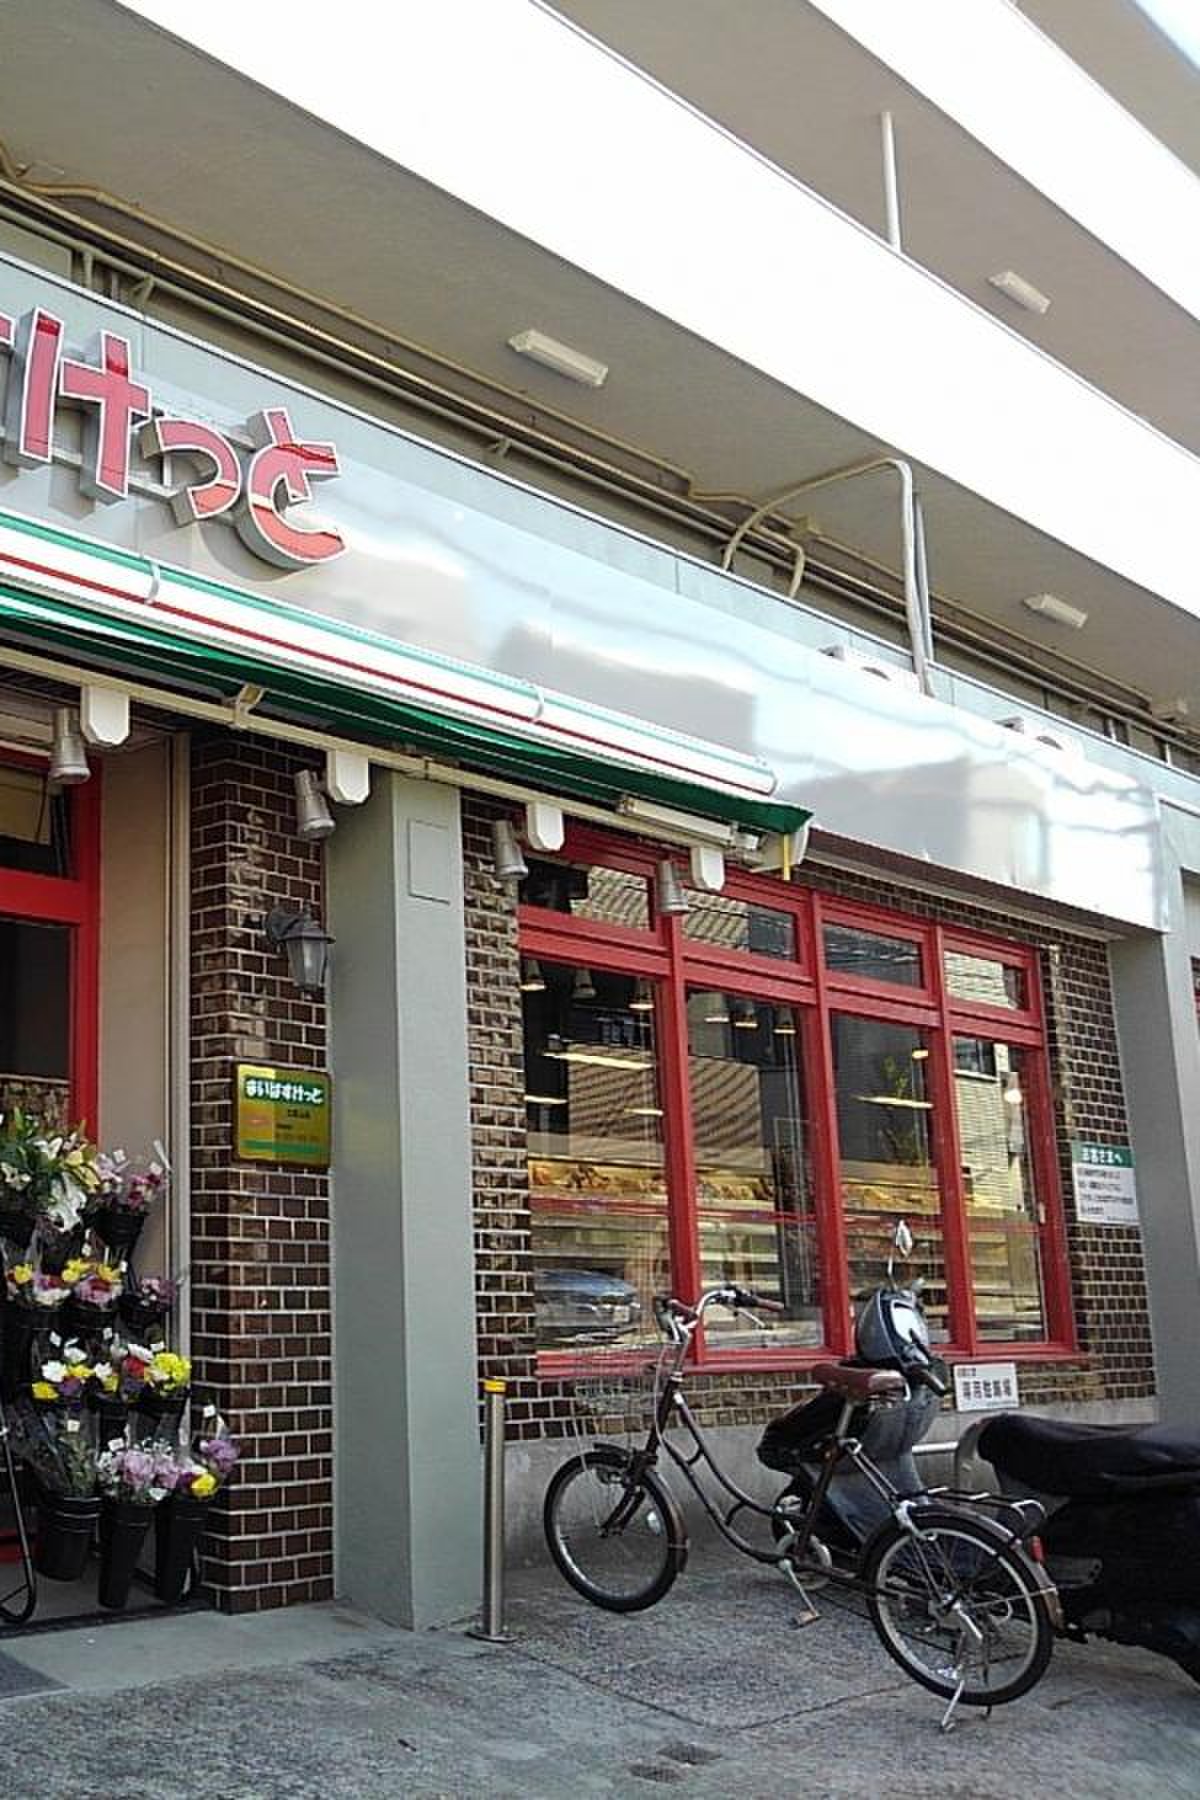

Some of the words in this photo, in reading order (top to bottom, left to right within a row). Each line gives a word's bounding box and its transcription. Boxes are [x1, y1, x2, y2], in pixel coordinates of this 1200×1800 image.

[245, 1079, 324, 1104] まいばすけっと
